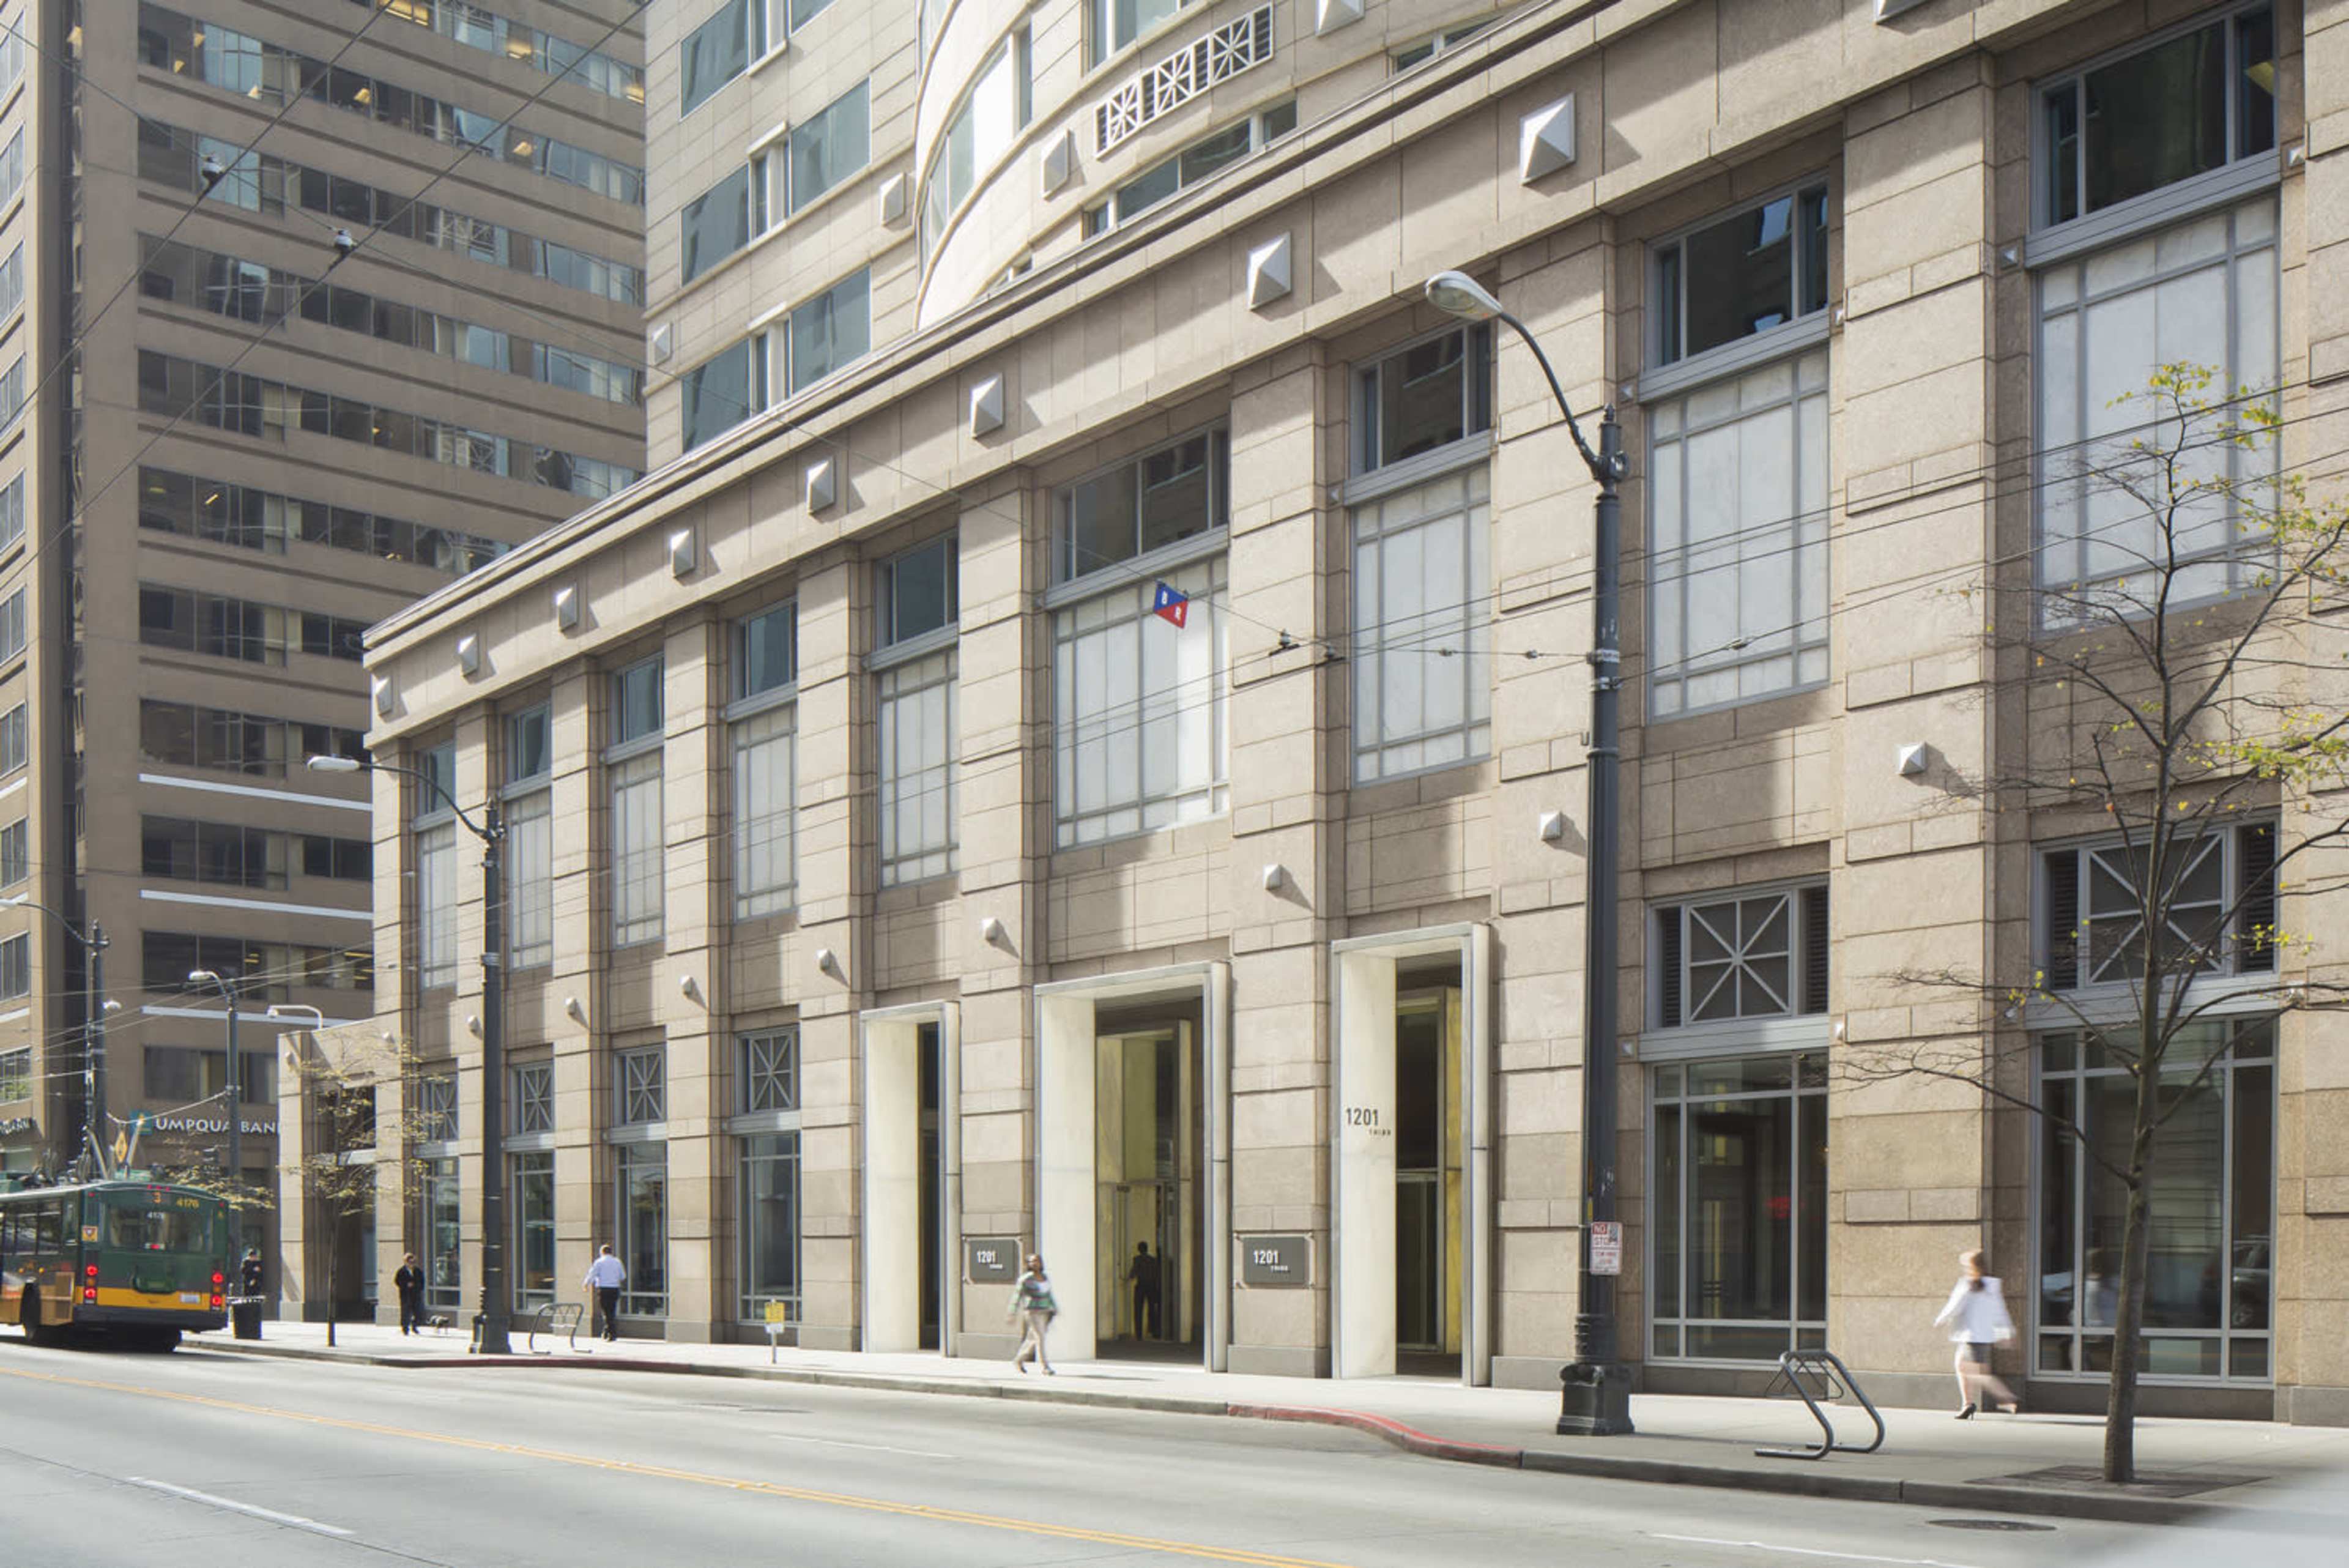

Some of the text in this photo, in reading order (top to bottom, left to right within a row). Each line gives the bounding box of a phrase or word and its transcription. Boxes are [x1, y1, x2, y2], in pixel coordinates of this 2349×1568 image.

[1345, 1107, 1379, 1126] 1201
[155, 1118, 230, 1132] UMPQUA
[151, 1191, 162, 1204] 3
[976, 1251, 996, 1263] 1201
[1253, 1249, 1278, 1264] 1201
